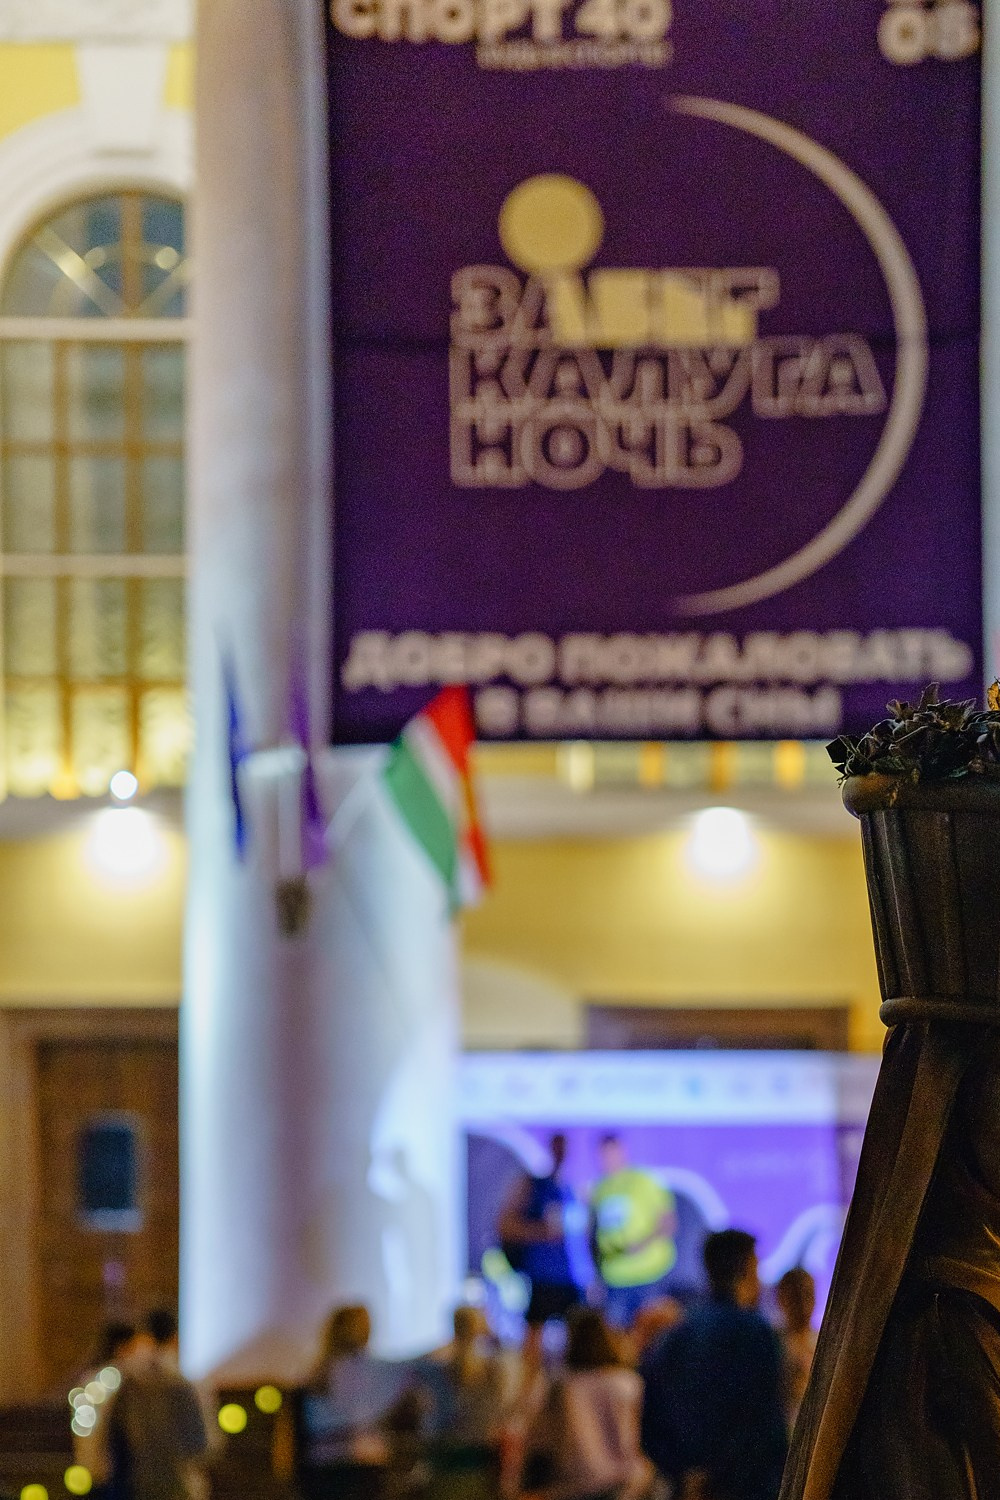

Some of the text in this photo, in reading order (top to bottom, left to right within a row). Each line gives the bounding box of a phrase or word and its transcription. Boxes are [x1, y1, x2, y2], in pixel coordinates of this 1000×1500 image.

[448, 333, 888, 417] КАЛУГА
[448, 403, 745, 490] НОЧЬ
[342, 629, 973, 692] ДОБРО ПОЖАЛОВАТЬ
